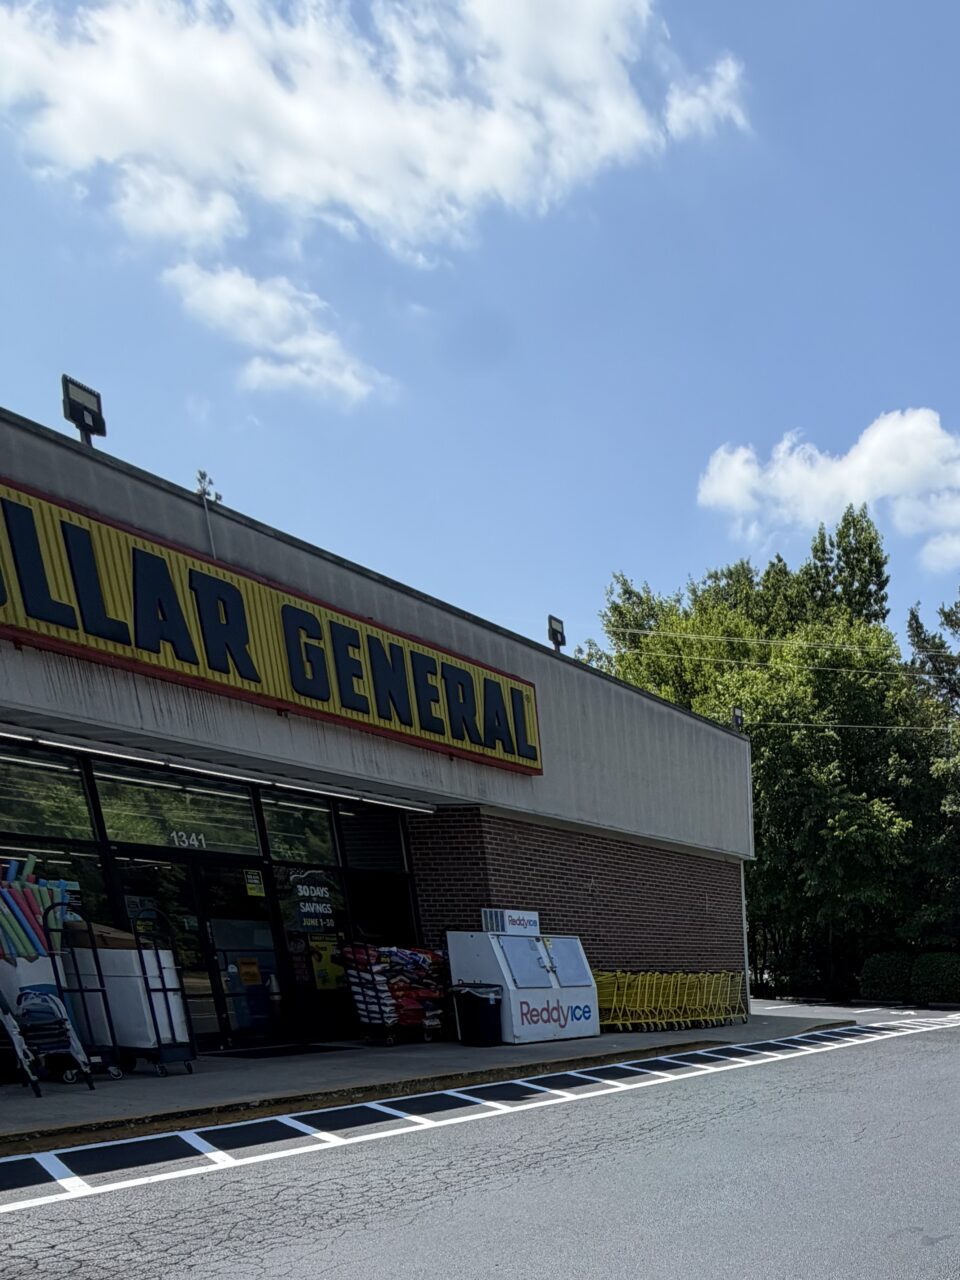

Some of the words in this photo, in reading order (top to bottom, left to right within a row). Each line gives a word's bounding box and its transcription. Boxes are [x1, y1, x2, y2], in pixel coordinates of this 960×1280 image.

[0, 498, 261, 683] LLAR
[281, 604, 538, 762] GENERAL
[170, 830, 207, 849] 1341
[297, 884, 310, 897] 30
[310, 885, 330, 898] DAYS
[299, 902, 333, 914] SAVINGS
[303, 917, 319, 927] JUNE
